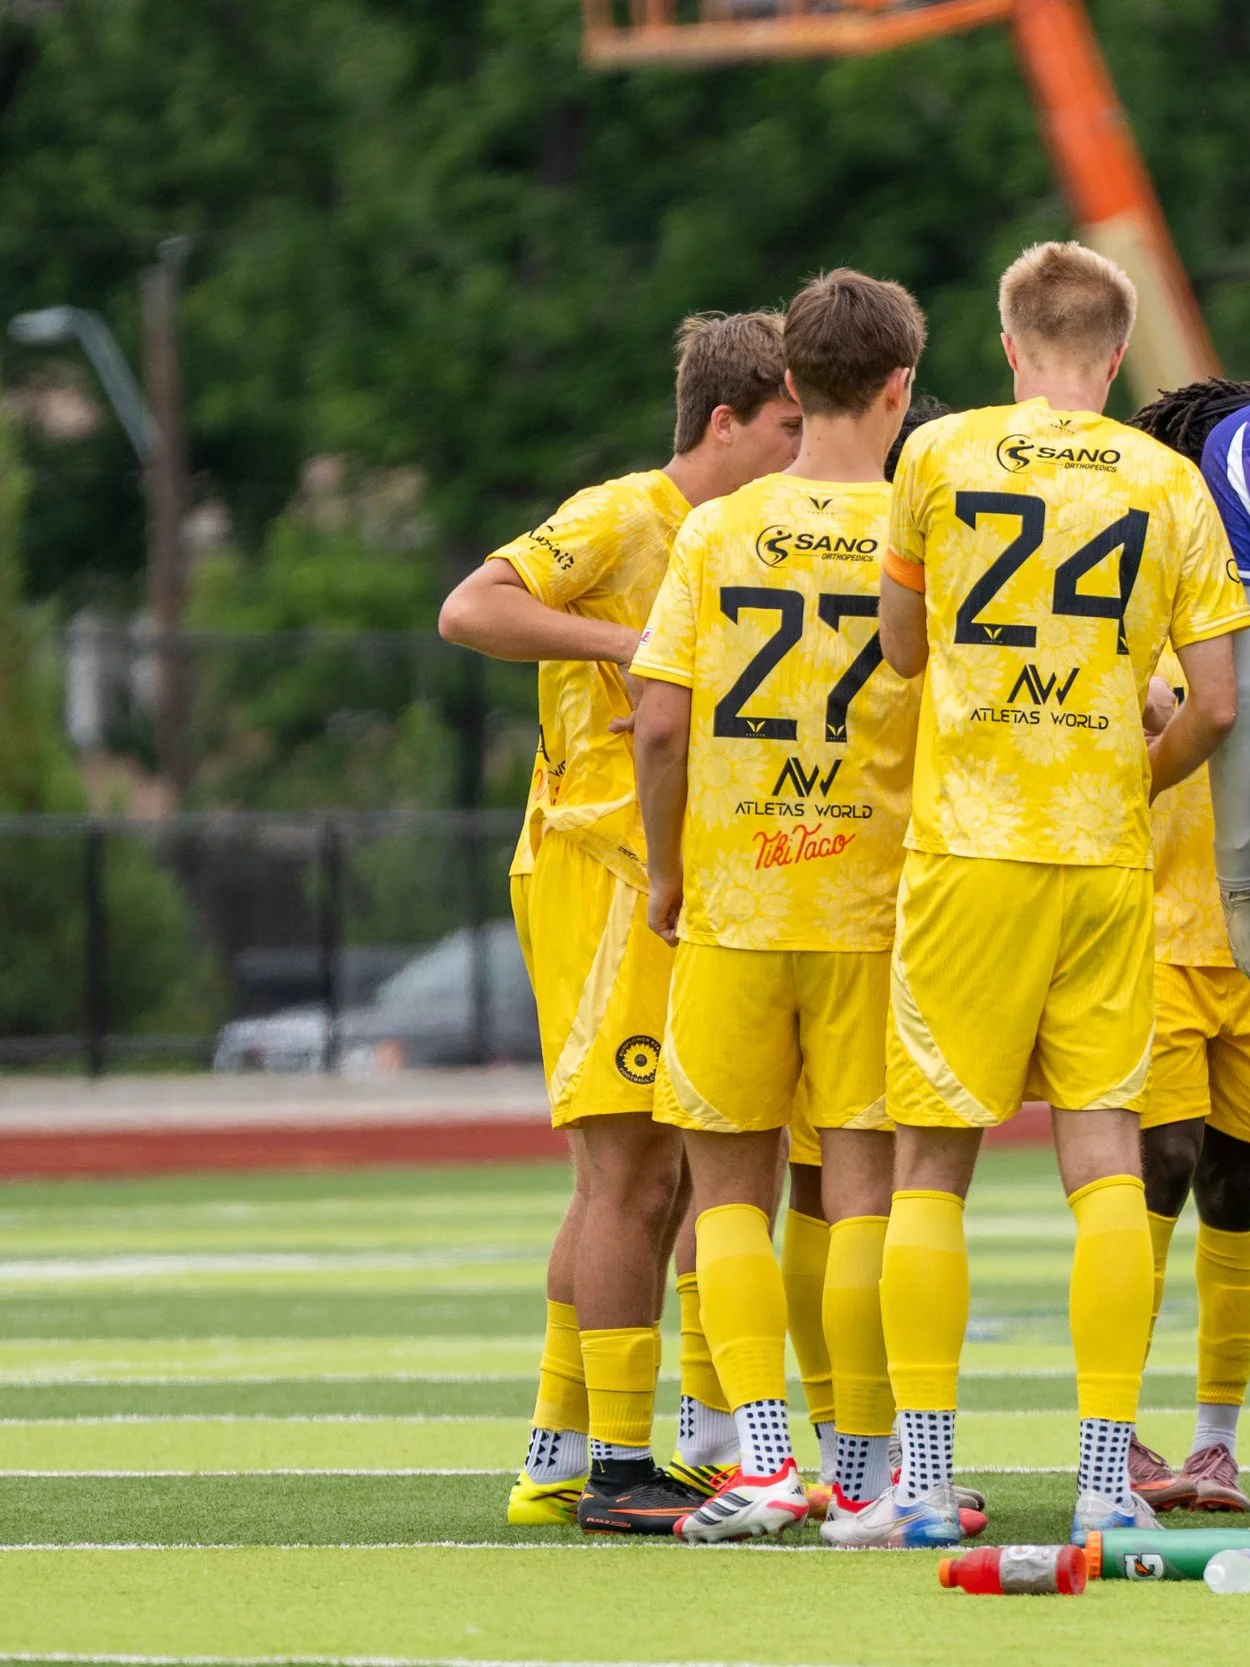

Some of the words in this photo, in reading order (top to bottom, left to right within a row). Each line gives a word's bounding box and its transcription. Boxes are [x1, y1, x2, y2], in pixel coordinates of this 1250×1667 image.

[1037, 447, 1121, 465] SANO
[1064, 462, 1117, 473] ORTHOPEDICS
[794, 533, 878, 554] SANO
[821, 552, 874, 562] ORTHOPEDICS
[954, 491, 1149, 655] 24
[713, 586, 884, 743] 27
[970, 708, 1040, 725] ATLETAS
[1050, 712, 1109, 730] WORLD
[735, 801, 805, 816] ATLETAS
[814, 804, 872, 819] WORLD
[752, 830, 793, 870] Tiki
[792, 823, 856, 864] Taco
